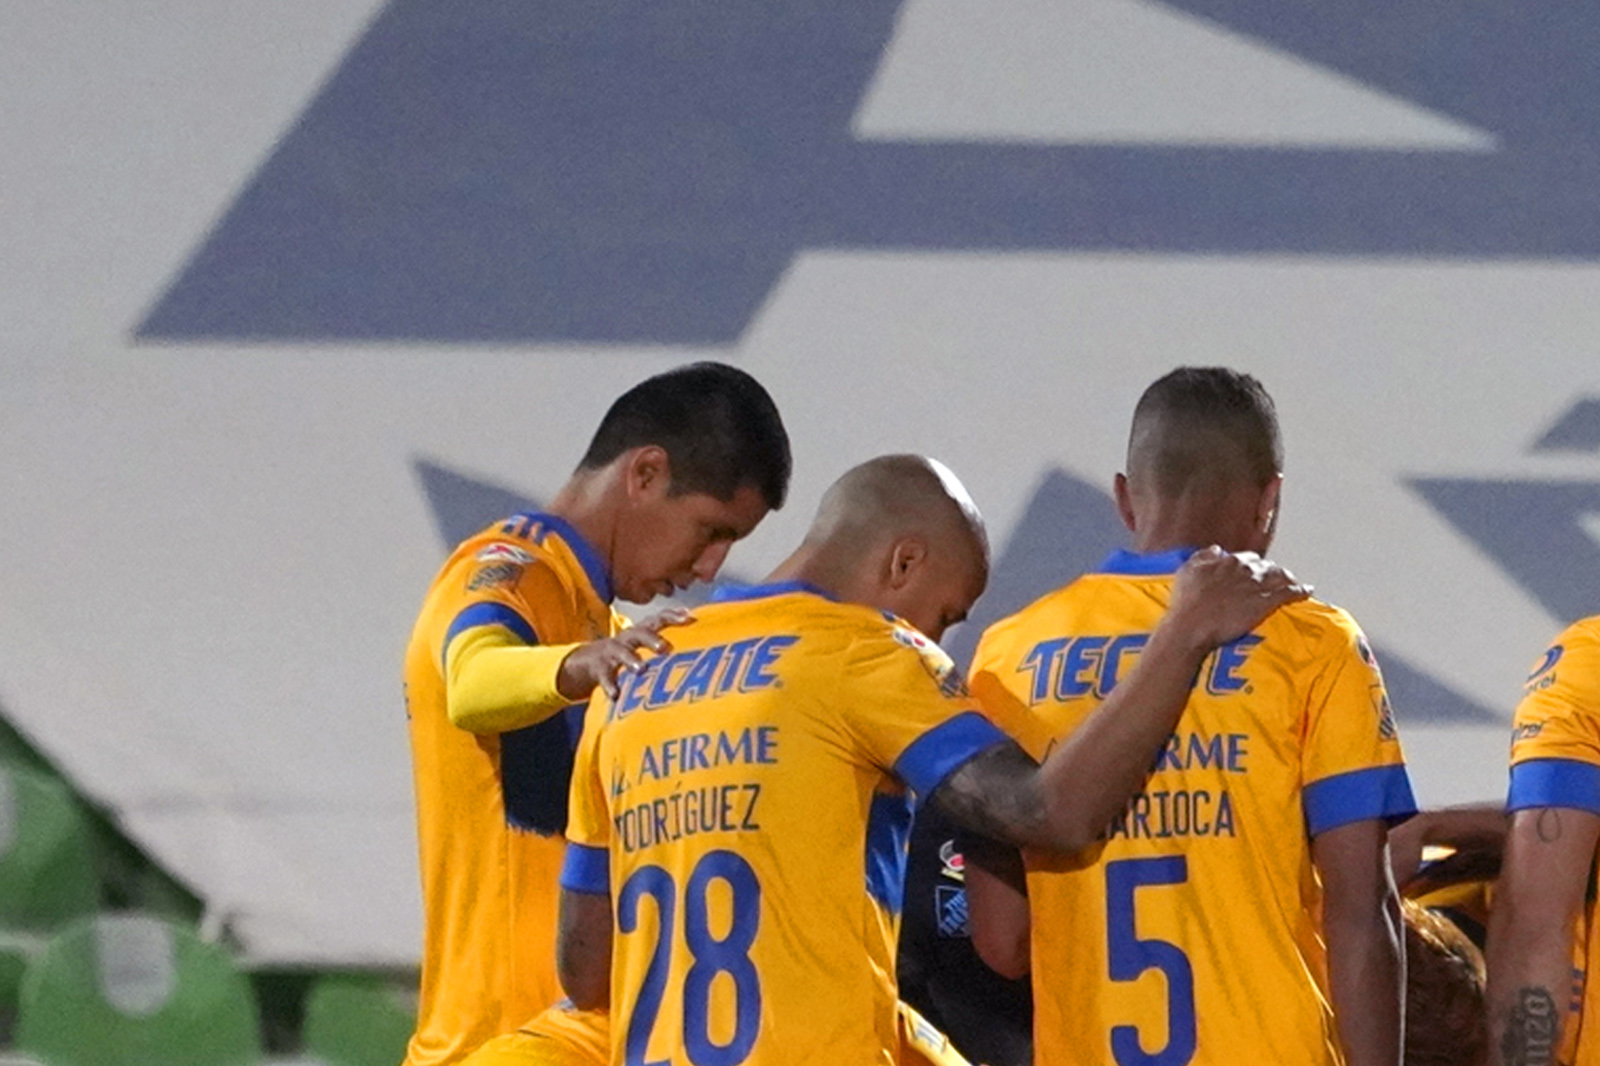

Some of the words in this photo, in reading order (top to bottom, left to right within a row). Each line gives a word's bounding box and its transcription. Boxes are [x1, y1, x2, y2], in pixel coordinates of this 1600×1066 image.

[1017, 632, 1265, 706] TECE
[638, 725, 780, 784] AFIRME
[1097, 789, 1236, 840] ARIOCA
